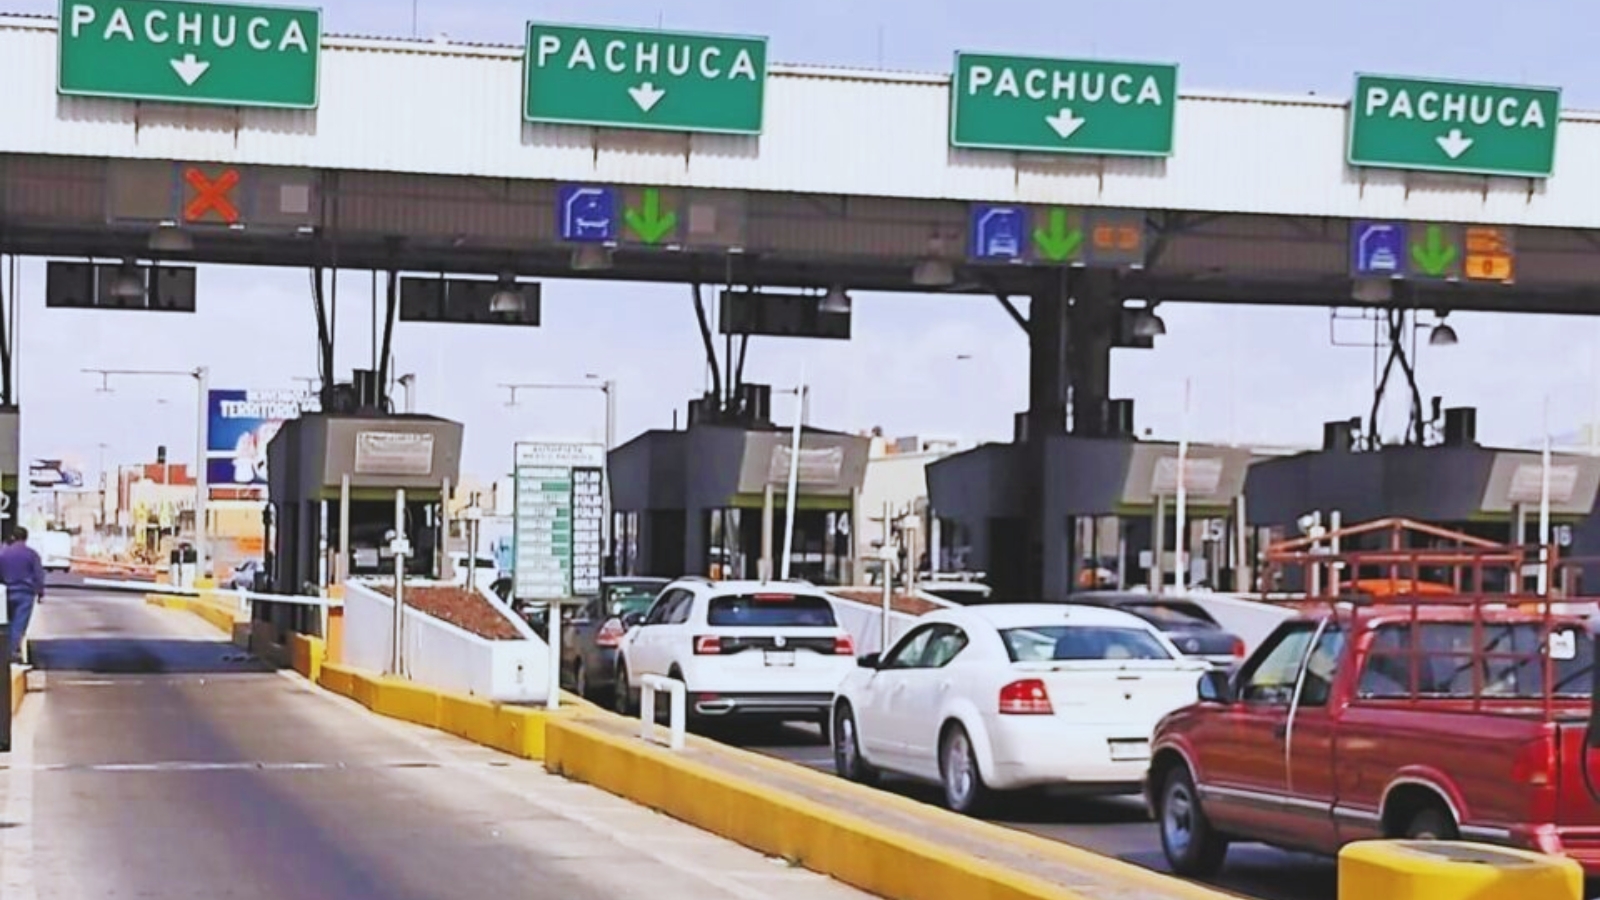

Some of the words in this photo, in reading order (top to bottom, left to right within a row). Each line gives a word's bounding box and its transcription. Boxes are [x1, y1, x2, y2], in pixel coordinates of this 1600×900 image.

[71, 4, 308, 52] PACHUCA
[538, 35, 756, 81] PACHUCA
[969, 65, 1161, 105] PACHUCA
[1366, 87, 1545, 128] PACHUCA
[221, 400, 299, 418] TERRITORIO
[826, 511, 849, 535] 14
[1552, 525, 1572, 547] 16
